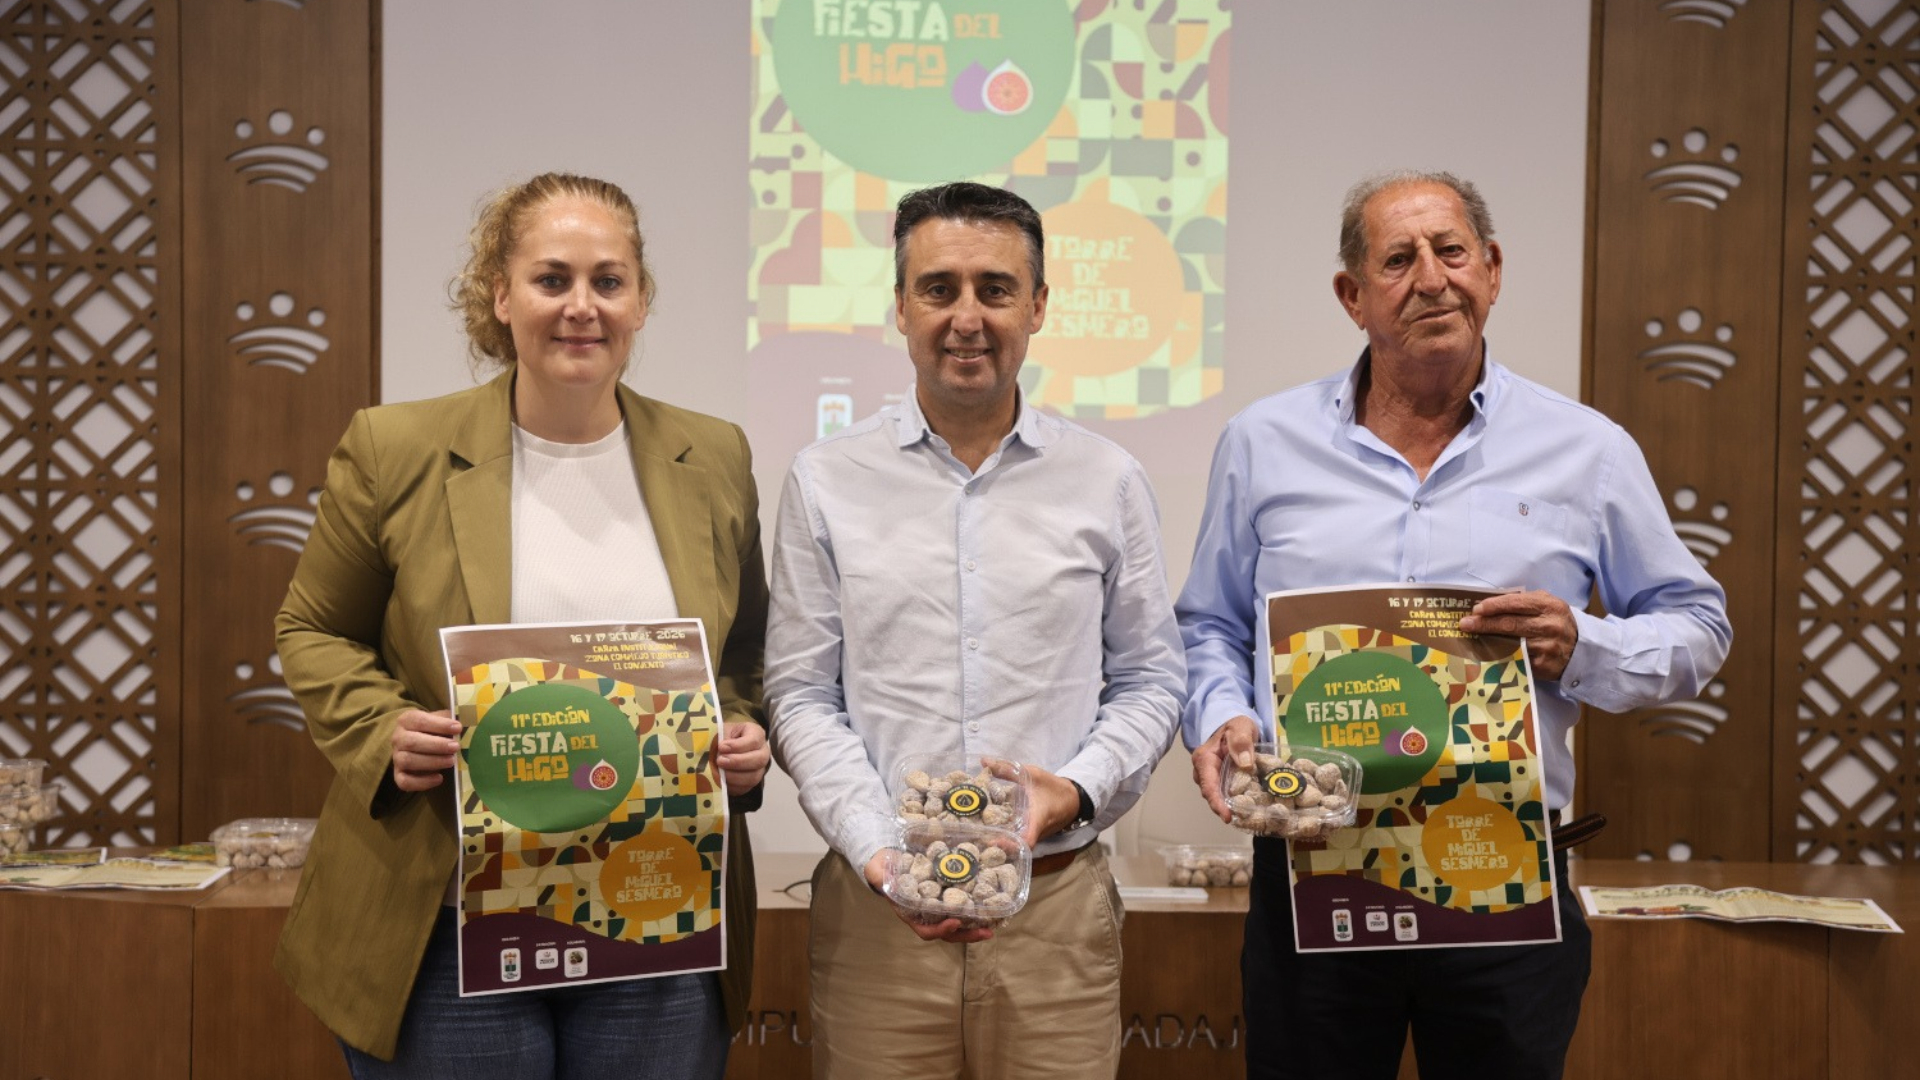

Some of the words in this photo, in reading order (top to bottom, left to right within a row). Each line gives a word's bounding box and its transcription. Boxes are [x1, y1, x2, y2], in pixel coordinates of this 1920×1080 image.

[953, 13, 1003, 39] DEL
[1049, 234, 1134, 260] TORRE
[1073, 261, 1107, 286] DE
[1037, 312, 1149, 339] ESMERO
[1388, 597, 1400, 607] 16
[1402, 598, 1410, 607] Y
[1426, 598, 1471, 608] OCTUBRE
[1400, 620, 1425, 628] ZONA
[570, 634, 582, 643] 16
[585, 634, 592, 643] Y
[608, 631, 652, 642] OCTUBRE
[656, 630, 685, 640] 2026
[584, 654, 609, 662] ZONA
[1381, 702, 1408, 717] DEL
[570, 734, 599, 750] DEL
[1446, 813, 1494, 829] TORRE
[1462, 828, 1481, 841] DE
[628, 847, 675, 863] TORRE
[1440, 855, 1509, 871] SESMERO
[641, 861, 660, 874] DE
[616, 885, 682, 903] SESMERO
[731, 1010, 813, 1047] IPU
[1121, 1012, 1240, 1050] ADAJ
